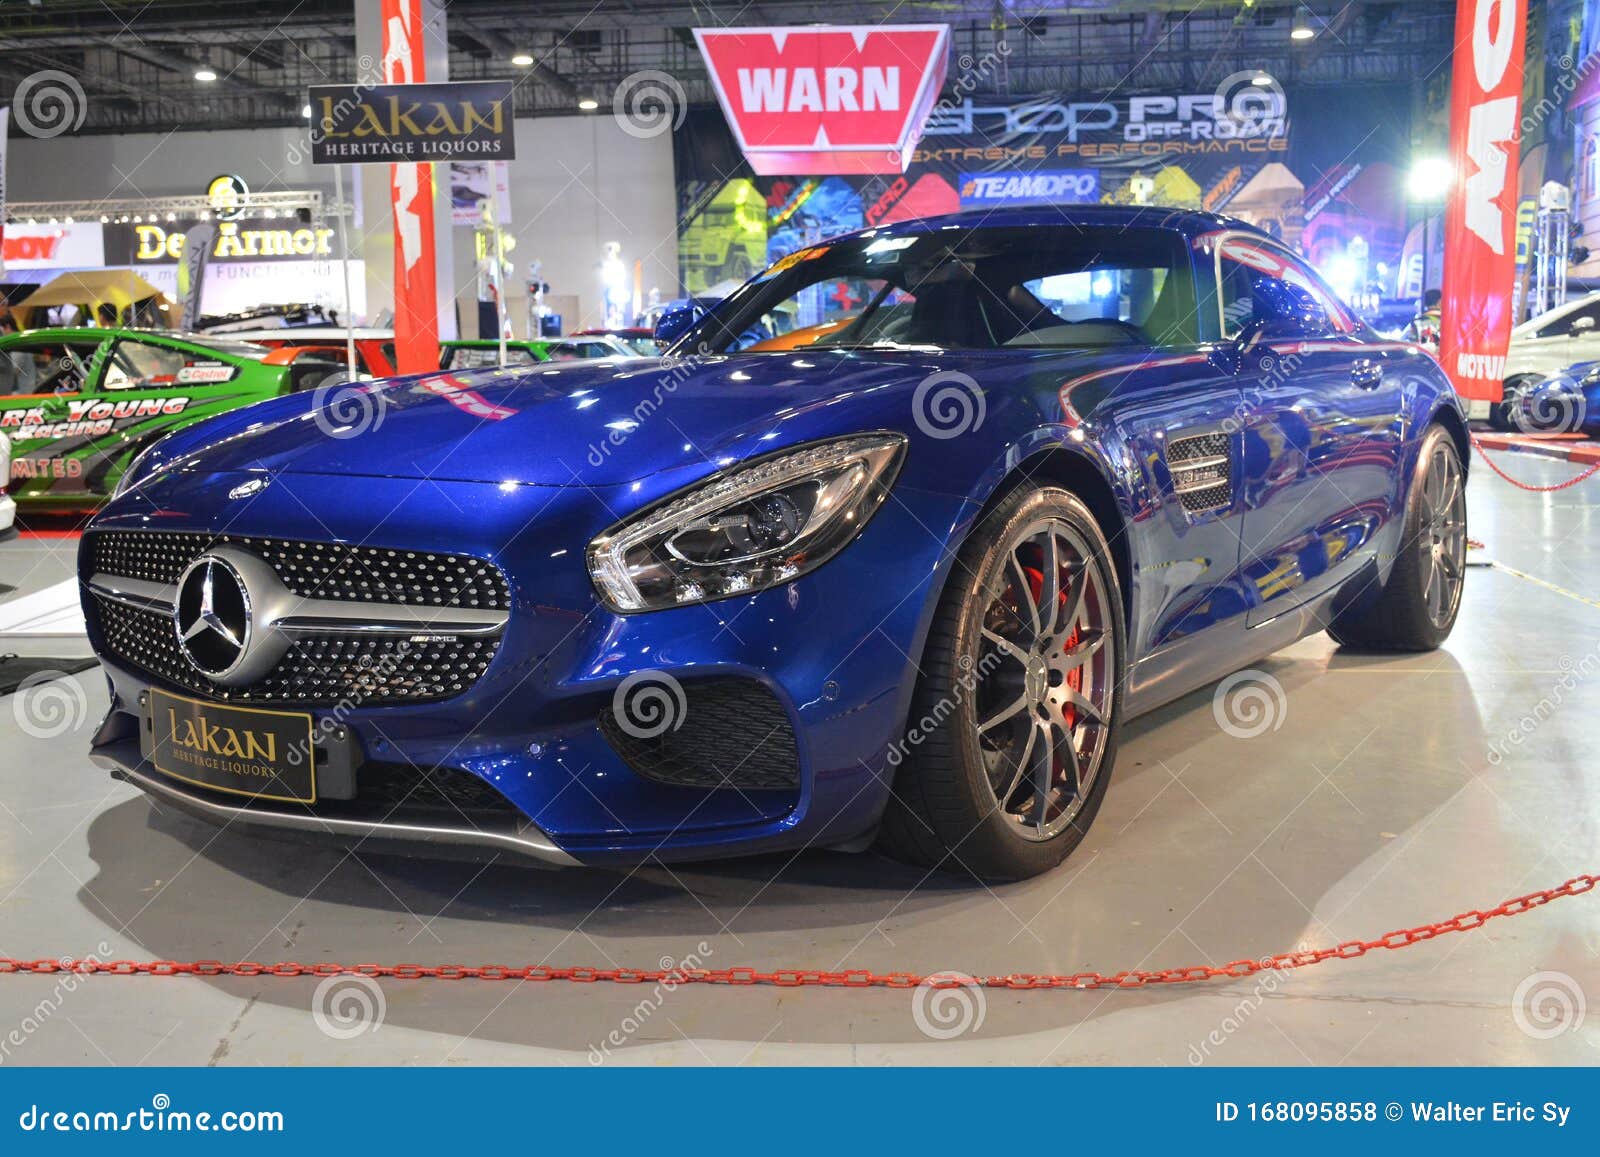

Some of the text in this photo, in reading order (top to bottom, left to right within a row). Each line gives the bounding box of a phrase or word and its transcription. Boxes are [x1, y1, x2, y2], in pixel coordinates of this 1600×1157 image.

[737, 66, 899, 112] WARN
[325, 139, 502, 156] HERITAGE LIQUORS
[910, 138, 1289, 163] EXTREME PERFORMANCE
[0, 397, 190, 427] RK YOUNG
[10, 458, 82, 478] MITED
[172, 748, 276, 778] HERITAGE LIQUORS
